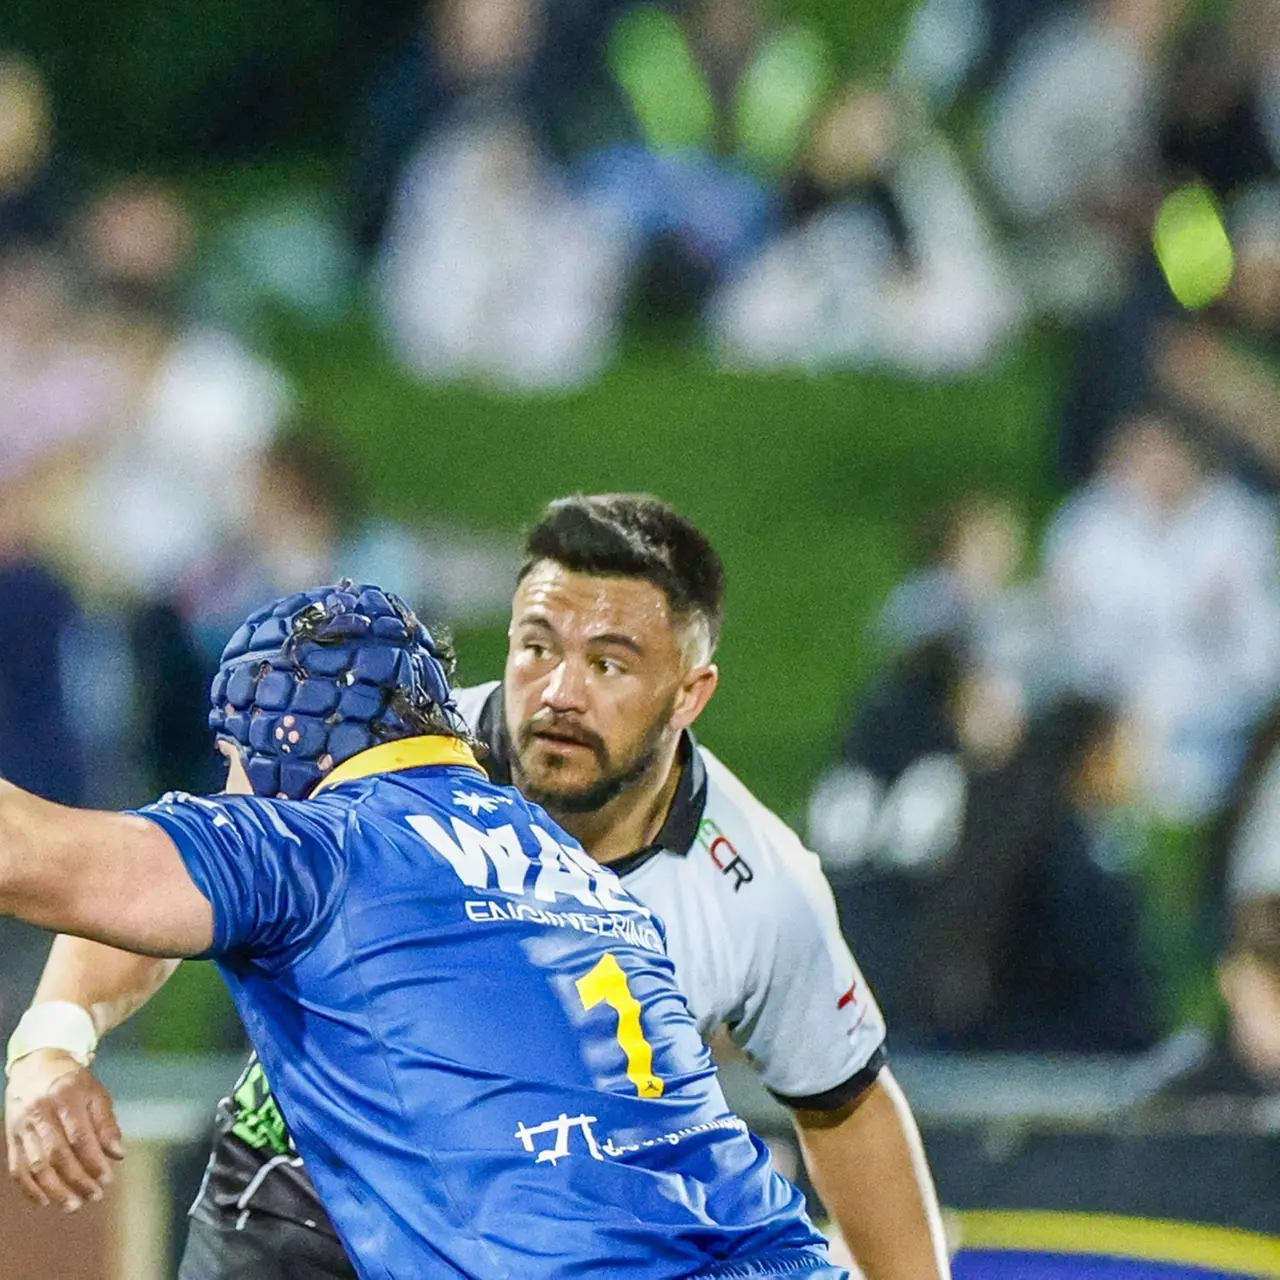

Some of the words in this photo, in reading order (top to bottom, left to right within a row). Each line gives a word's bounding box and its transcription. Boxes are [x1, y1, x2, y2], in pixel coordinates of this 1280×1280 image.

[404, 814, 651, 919] WAE
[696, 817, 754, 893] ECR
[574, 952, 665, 1099] 1
